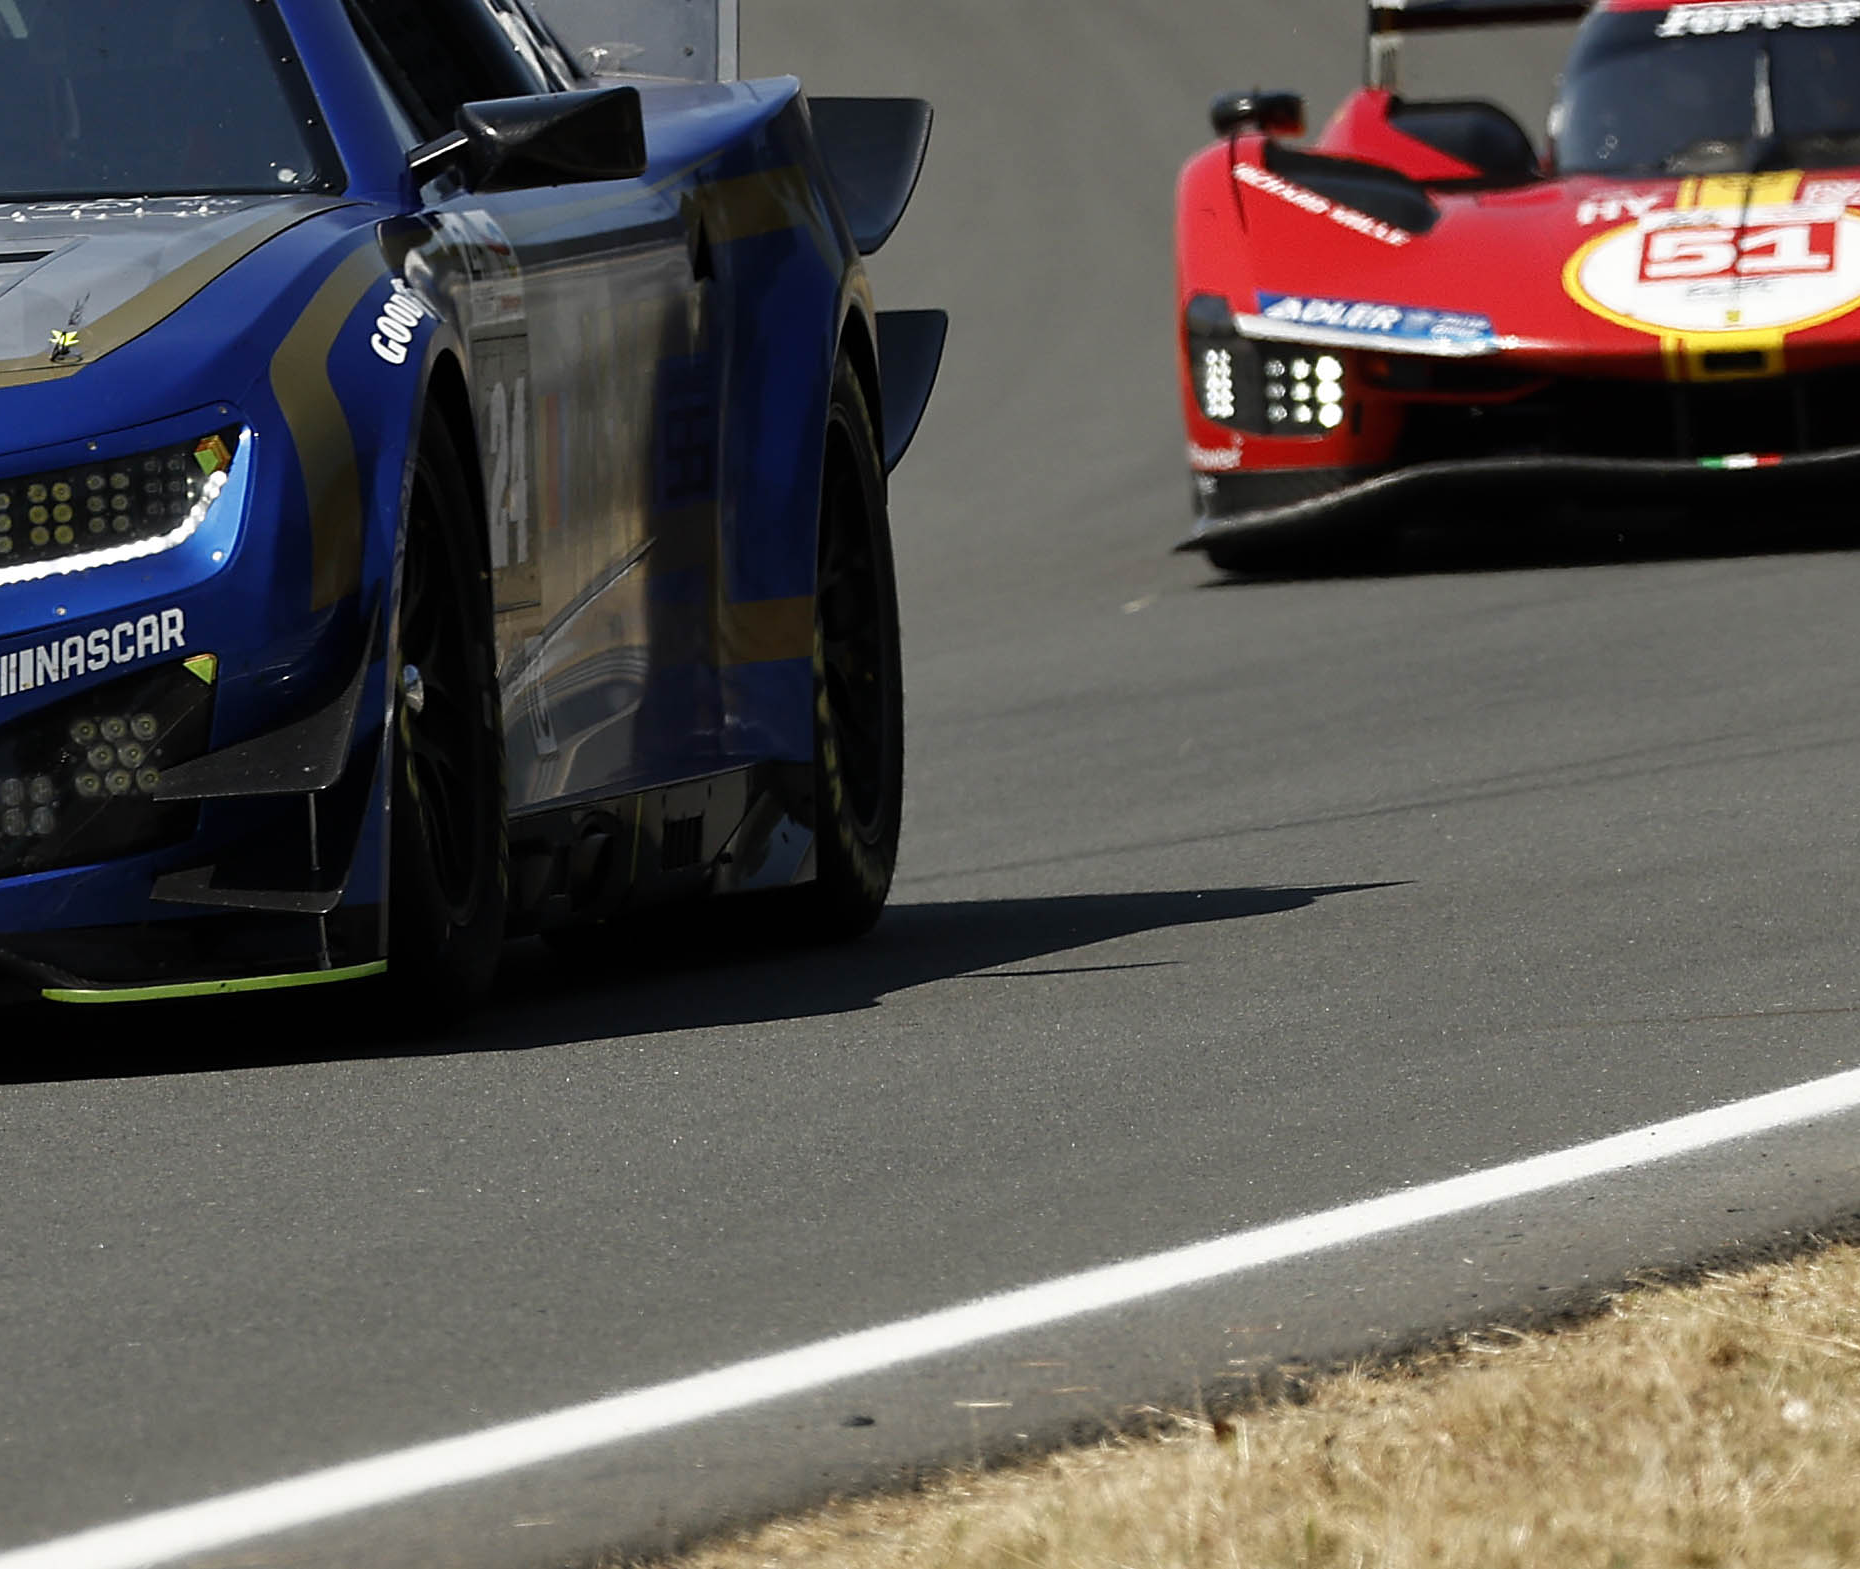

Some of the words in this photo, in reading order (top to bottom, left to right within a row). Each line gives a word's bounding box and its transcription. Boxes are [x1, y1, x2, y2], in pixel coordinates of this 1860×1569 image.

[1641, 224, 1833, 281] 51
[1262, 295, 1405, 331] ADLER
[489, 376, 529, 570] 24
[35, 606, 187, 688] NASCAR
